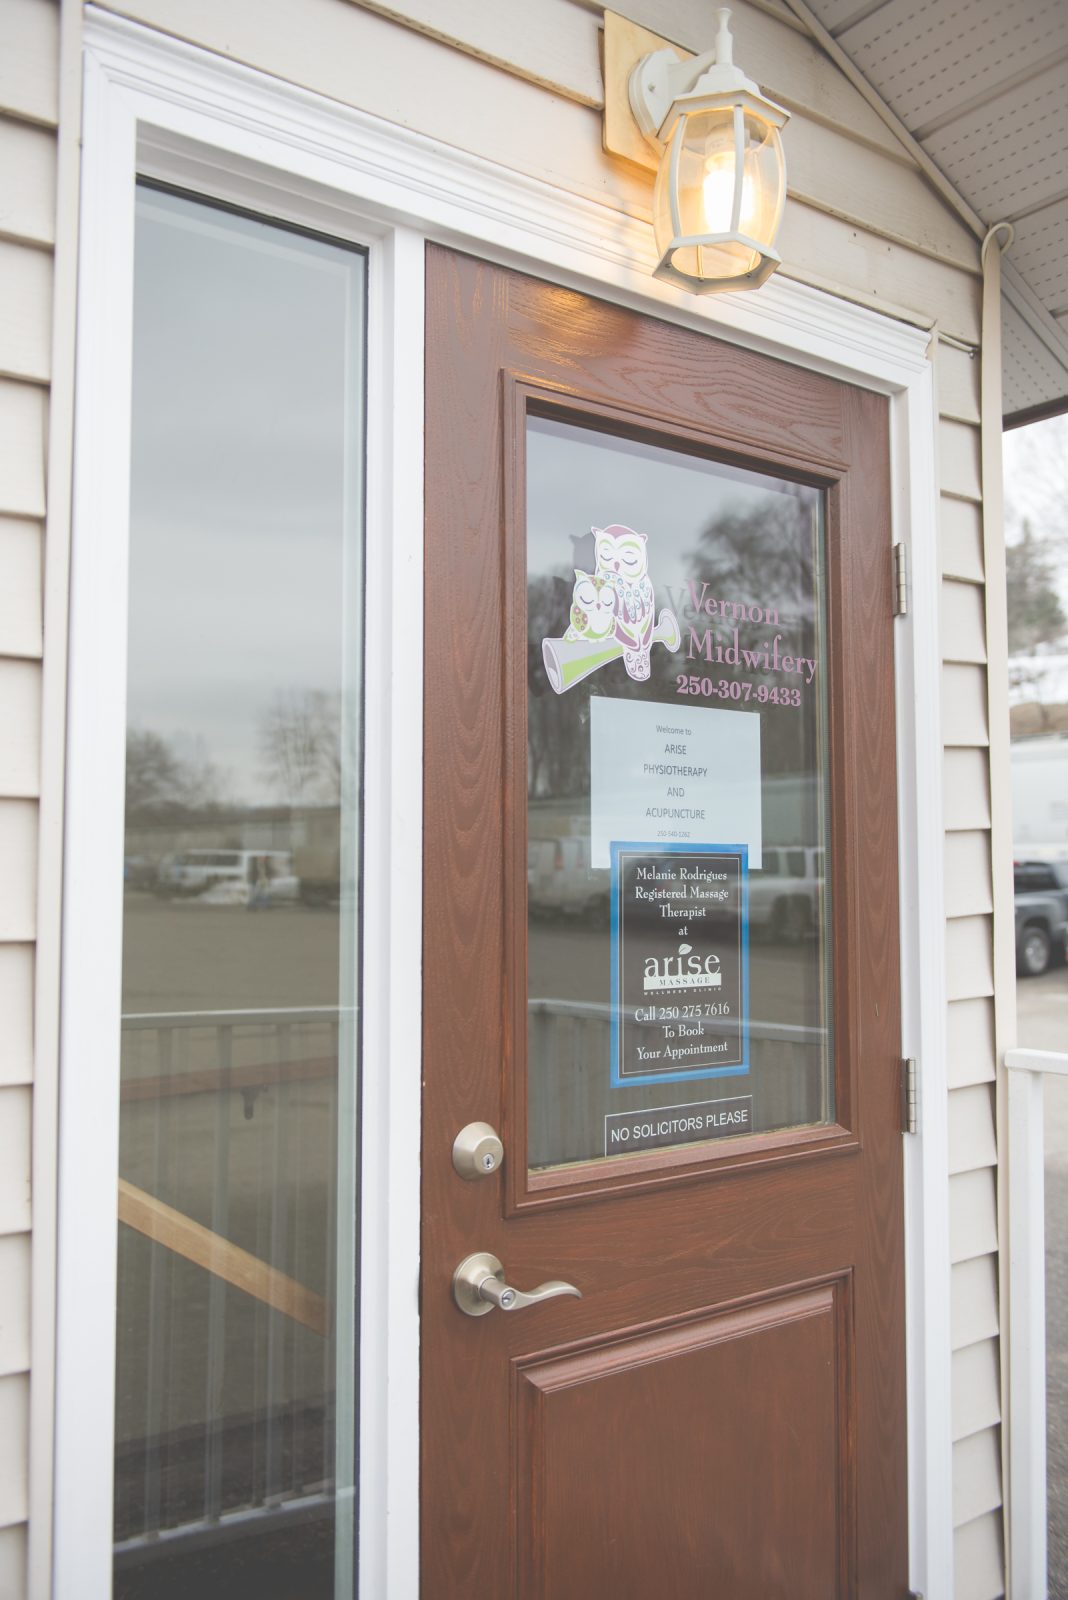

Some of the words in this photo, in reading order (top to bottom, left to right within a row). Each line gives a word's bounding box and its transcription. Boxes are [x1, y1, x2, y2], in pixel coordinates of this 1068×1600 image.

[687, 579, 780, 625] Vernon
[686, 626, 818, 683] Midwifery
[676, 675, 801, 706] 250-307-9433
[656, 725, 684, 735] Welcome
[685, 728, 692, 736] to
[664, 743, 687, 755] ARISE
[643, 763, 708, 777] PHYSIOTHERAPY
[666, 787, 685, 798] AND
[645, 807, 706, 820] ACUPUNCTURE
[636, 865, 677, 881] Melanie
[679, 865, 728, 883] Rodrigues
[635, 884, 687, 902] Registered
[690, 885, 729, 901] Massage
[659, 903, 707, 920] Therapist
[678, 926, 688, 935] at
[644, 954, 720, 977] arise
[659, 976, 710, 986] MASSAGE
[634, 1006, 656, 1022] Call
[658, 1006, 680, 1020] 250
[681, 1005, 702, 1018] 275
[704, 1001, 730, 1016] 7616
[662, 1025, 675, 1039] To
[678, 1022, 705, 1037] Book
[636, 1046, 661, 1060] Your
[663, 1041, 728, 1059] Appointment
[611, 1127, 630, 1143] NO
[632, 1116, 703, 1139] SOLICITORS
[706, 1109, 749, 1127] PLEASE
